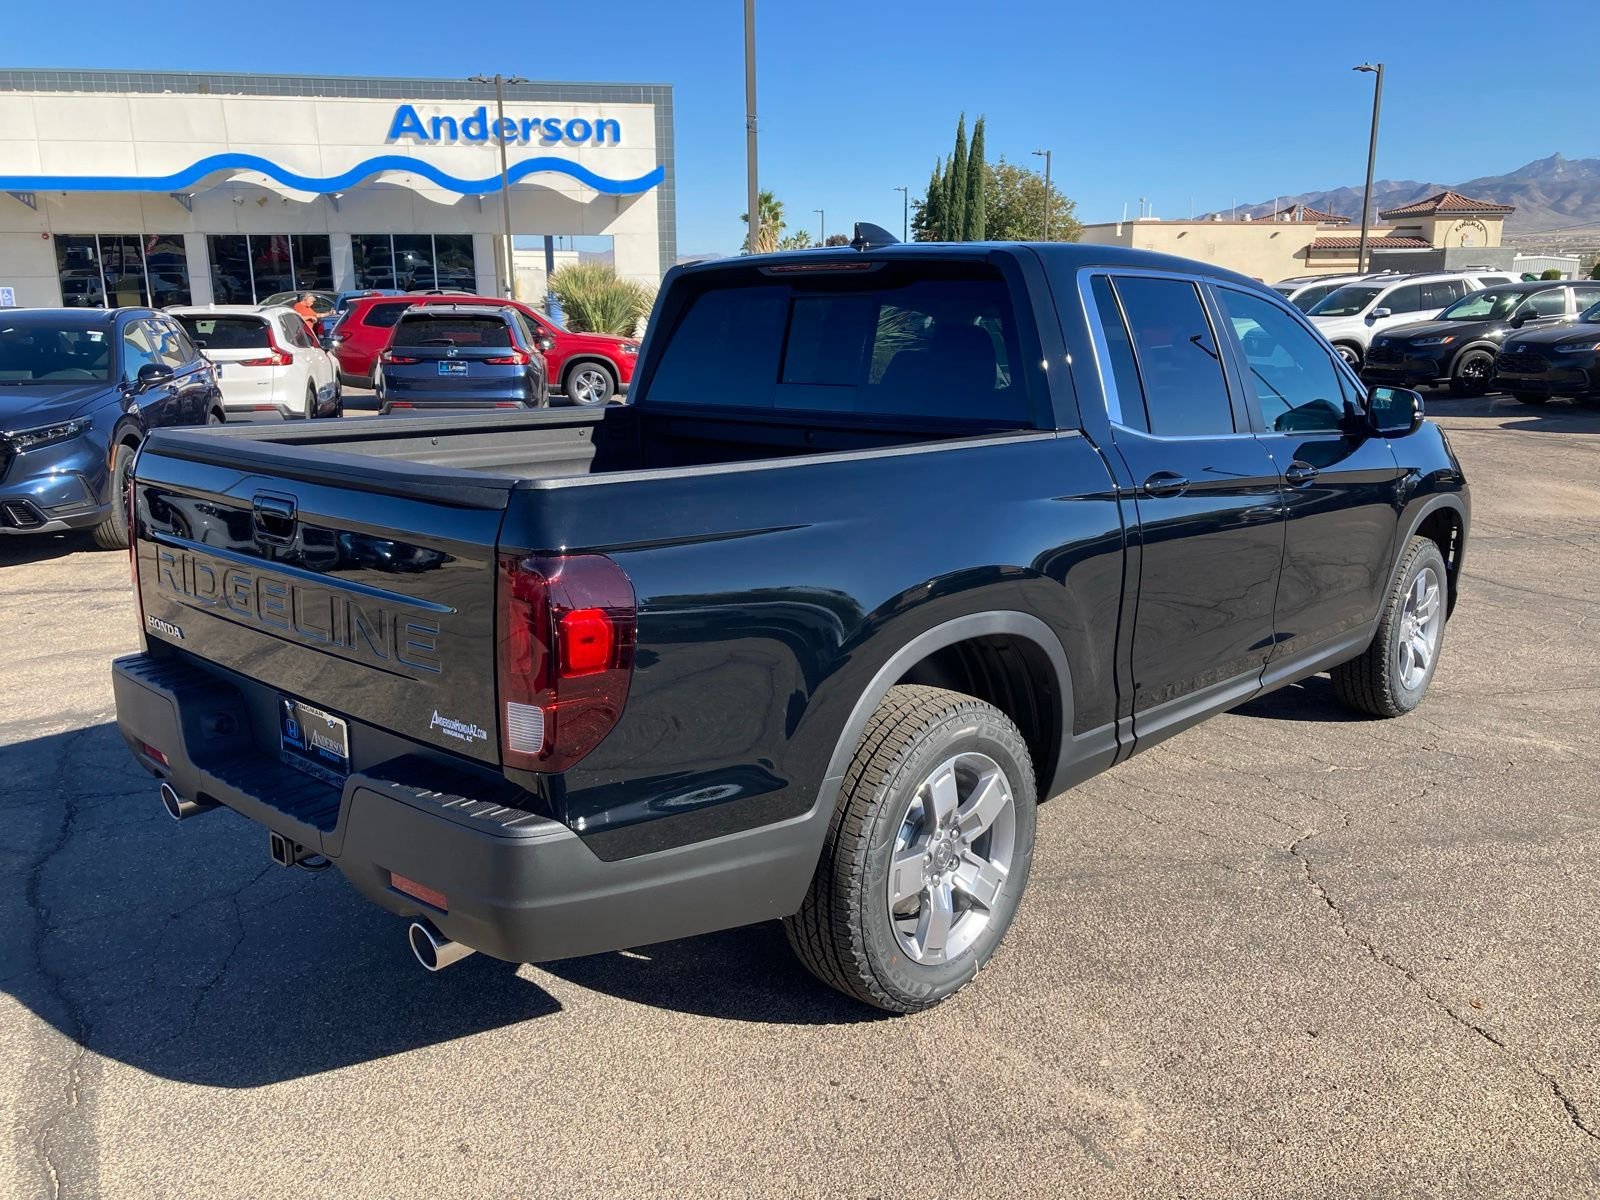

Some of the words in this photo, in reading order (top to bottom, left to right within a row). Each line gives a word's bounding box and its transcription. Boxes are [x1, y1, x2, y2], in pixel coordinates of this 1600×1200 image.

[388, 104, 621, 143] Anderson
[155, 544, 442, 674] RIDGELINE
[147, 615, 183, 640] HONDA
[308, 729, 346, 756] ANDERSON
